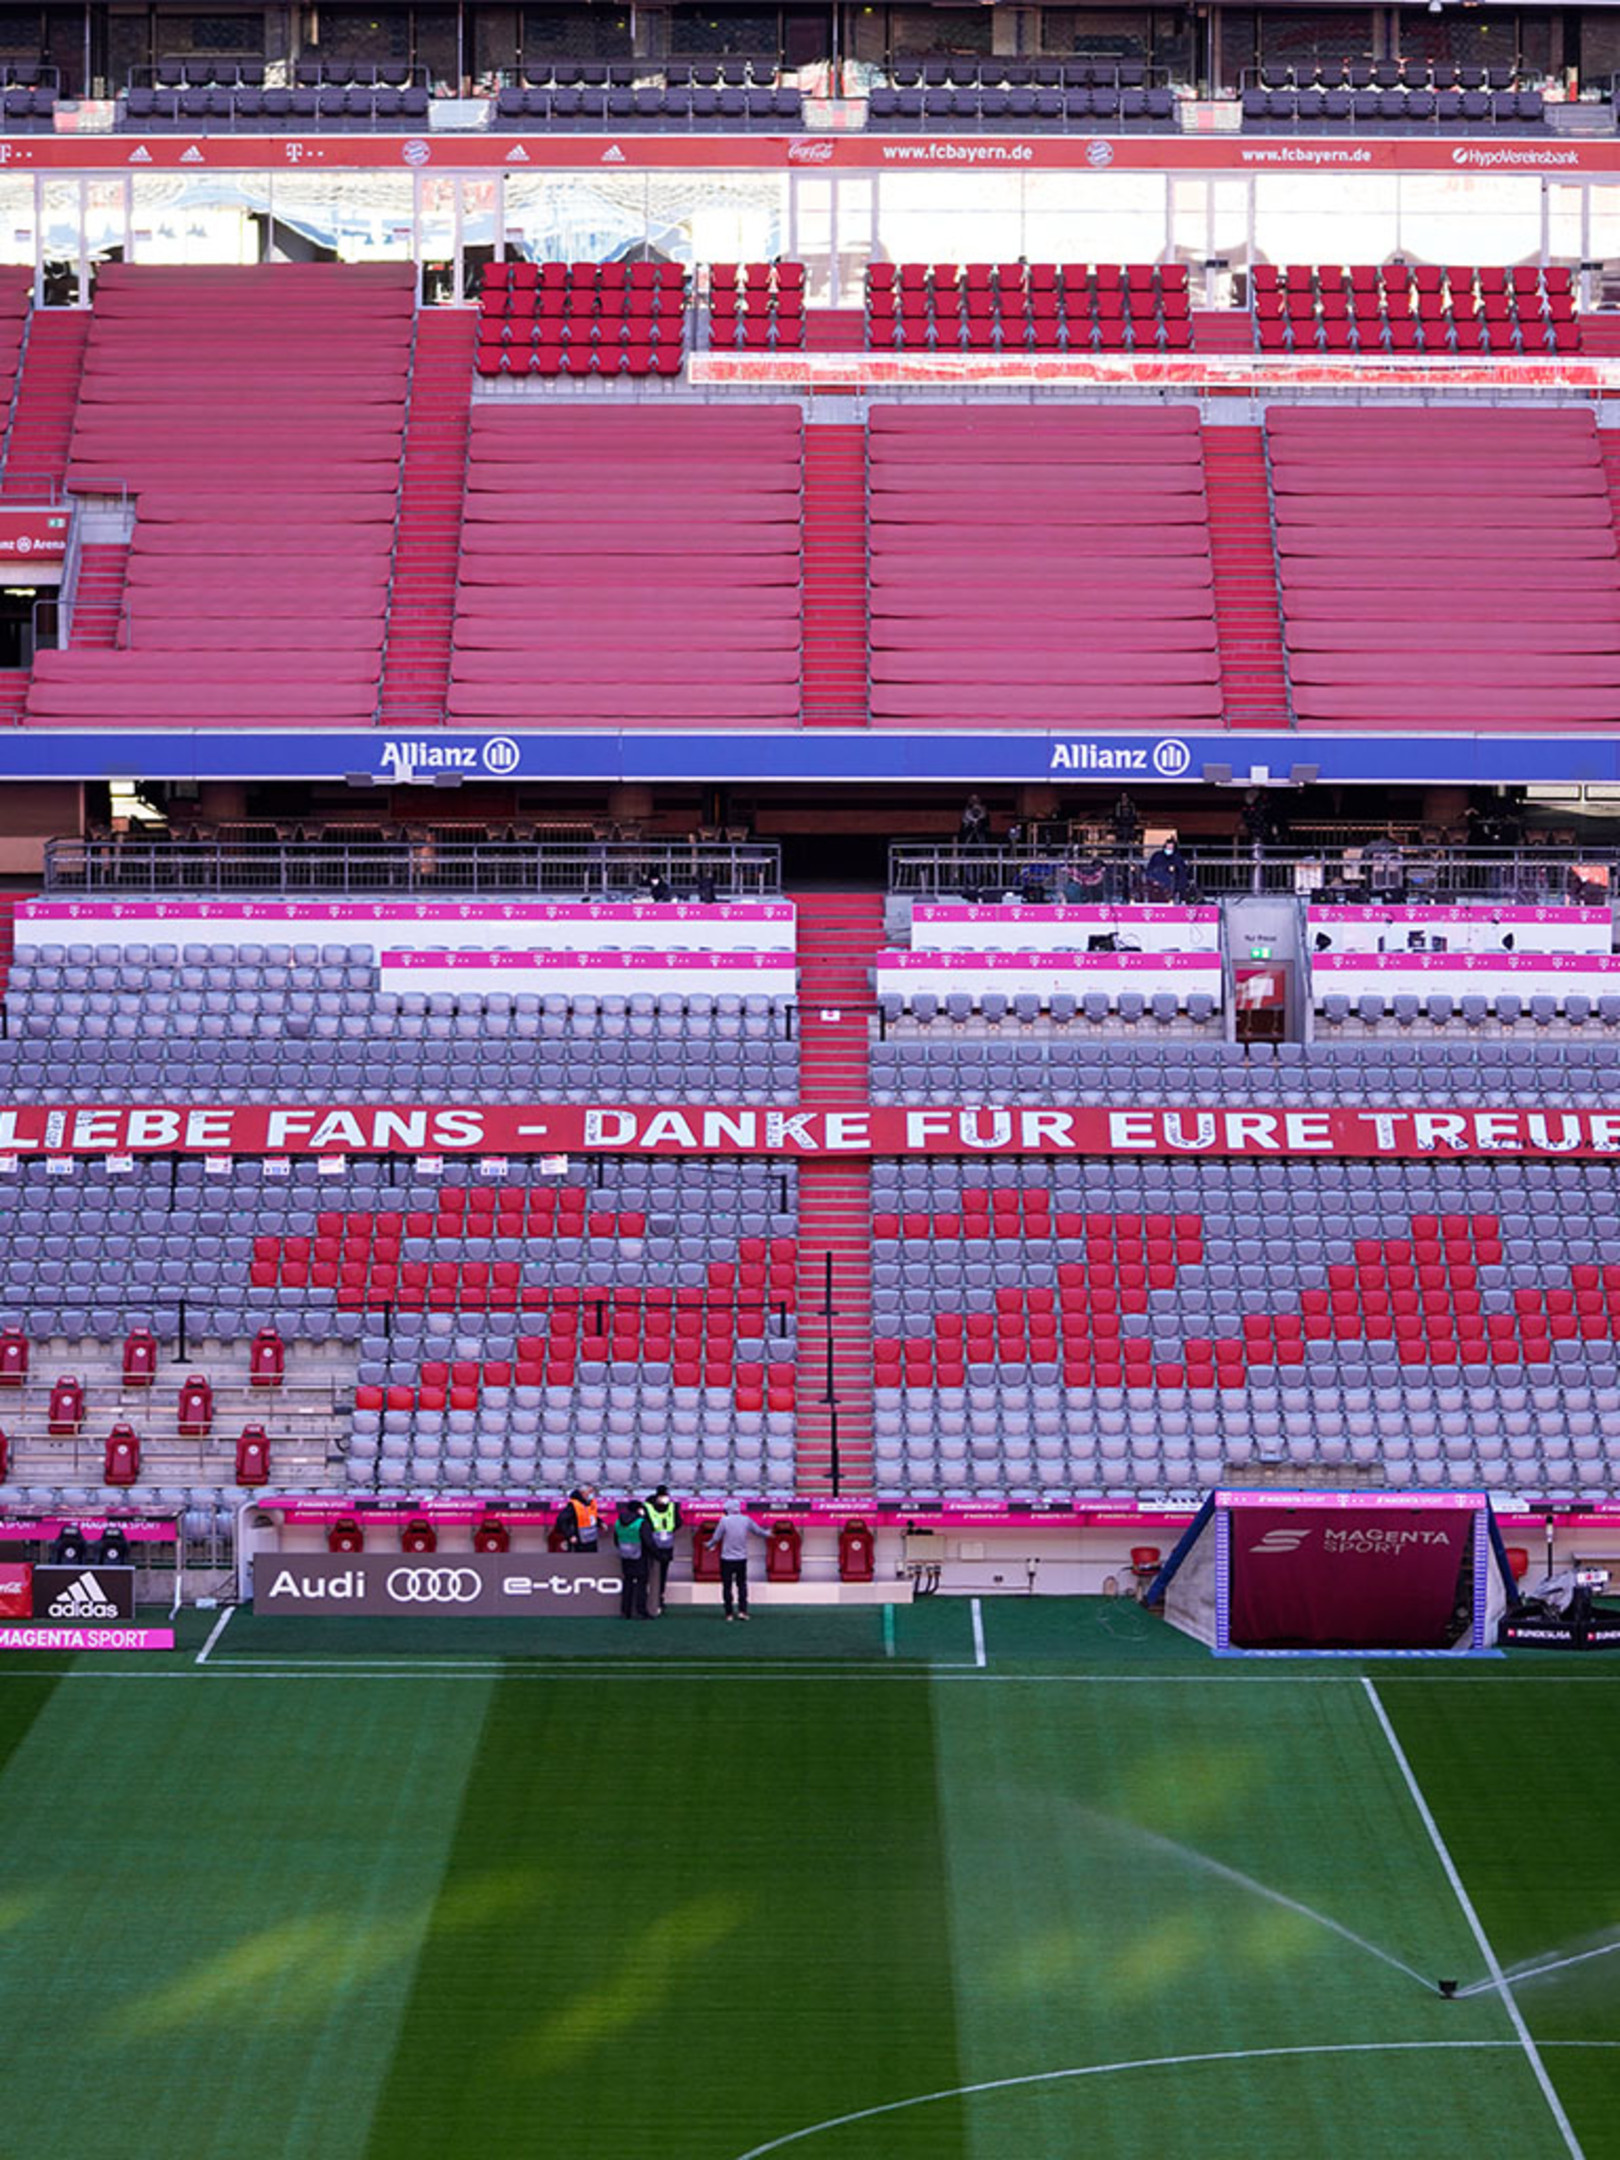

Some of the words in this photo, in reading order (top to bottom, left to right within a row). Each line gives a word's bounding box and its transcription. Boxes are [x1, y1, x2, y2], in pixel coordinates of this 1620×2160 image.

[883, 144, 1033, 162] www.fcbayern.de
[1241, 147, 1372, 164] www.fcbayern.de
[1468, 148, 1579, 166] HypoVereinsbank
[33, 539, 67, 550] Arena
[380, 742, 478, 767] Allianz
[1050, 744, 1148, 769] Allianz
[0, 1110, 235, 1148] LIEBE
[267, 1111, 484, 1148] FANS
[584, 1109, 872, 1149] DANKE
[906, 1104, 1076, 1149] FÜR
[1109, 1112, 1334, 1150] EURE
[1357, 1113, 1620, 1152] TREUE
[1324, 1528, 1450, 1545] MAGENTA
[1323, 1539, 1404, 1555] SPORT
[269, 1570, 365, 1598] Audi
[503, 1575, 624, 1595] e-tro
[48, 1601, 119, 1619] adidas
[0, 1630, 84, 1647] MAGENTA
[87, 1630, 150, 1647] SPORT
[1517, 1629, 1572, 1640] BUNDESLIGA
